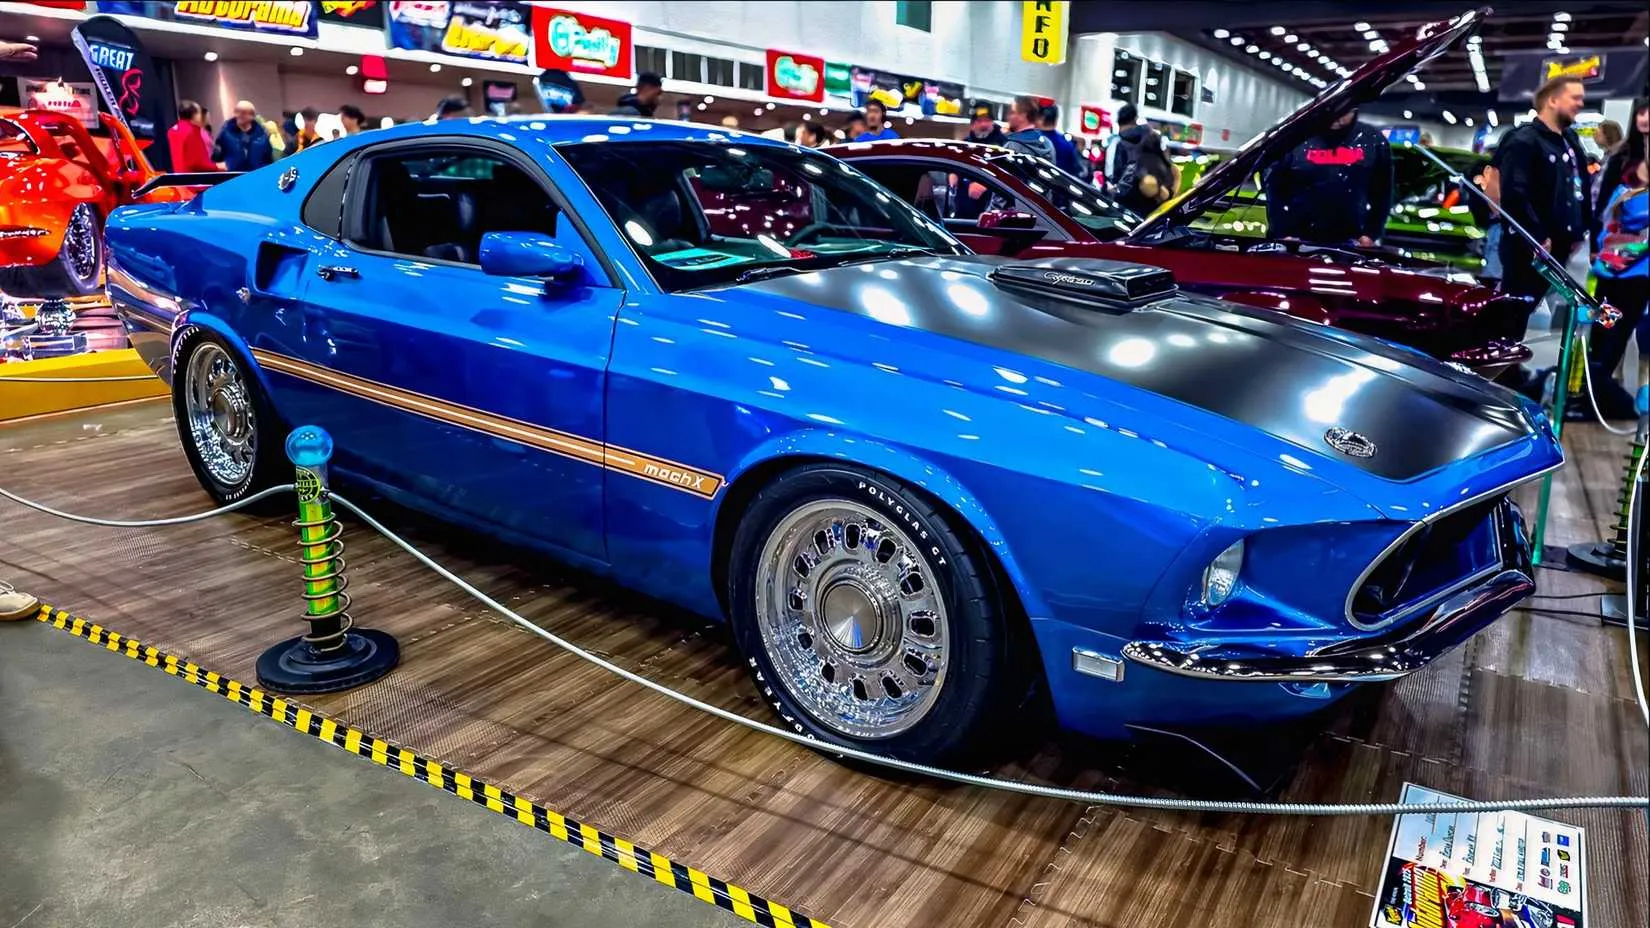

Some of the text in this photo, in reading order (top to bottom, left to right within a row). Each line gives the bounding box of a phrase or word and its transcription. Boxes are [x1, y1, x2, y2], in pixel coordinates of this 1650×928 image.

[90, 44, 134, 71] GREAT
[859, 481, 946, 565] POLYGLAS GT
